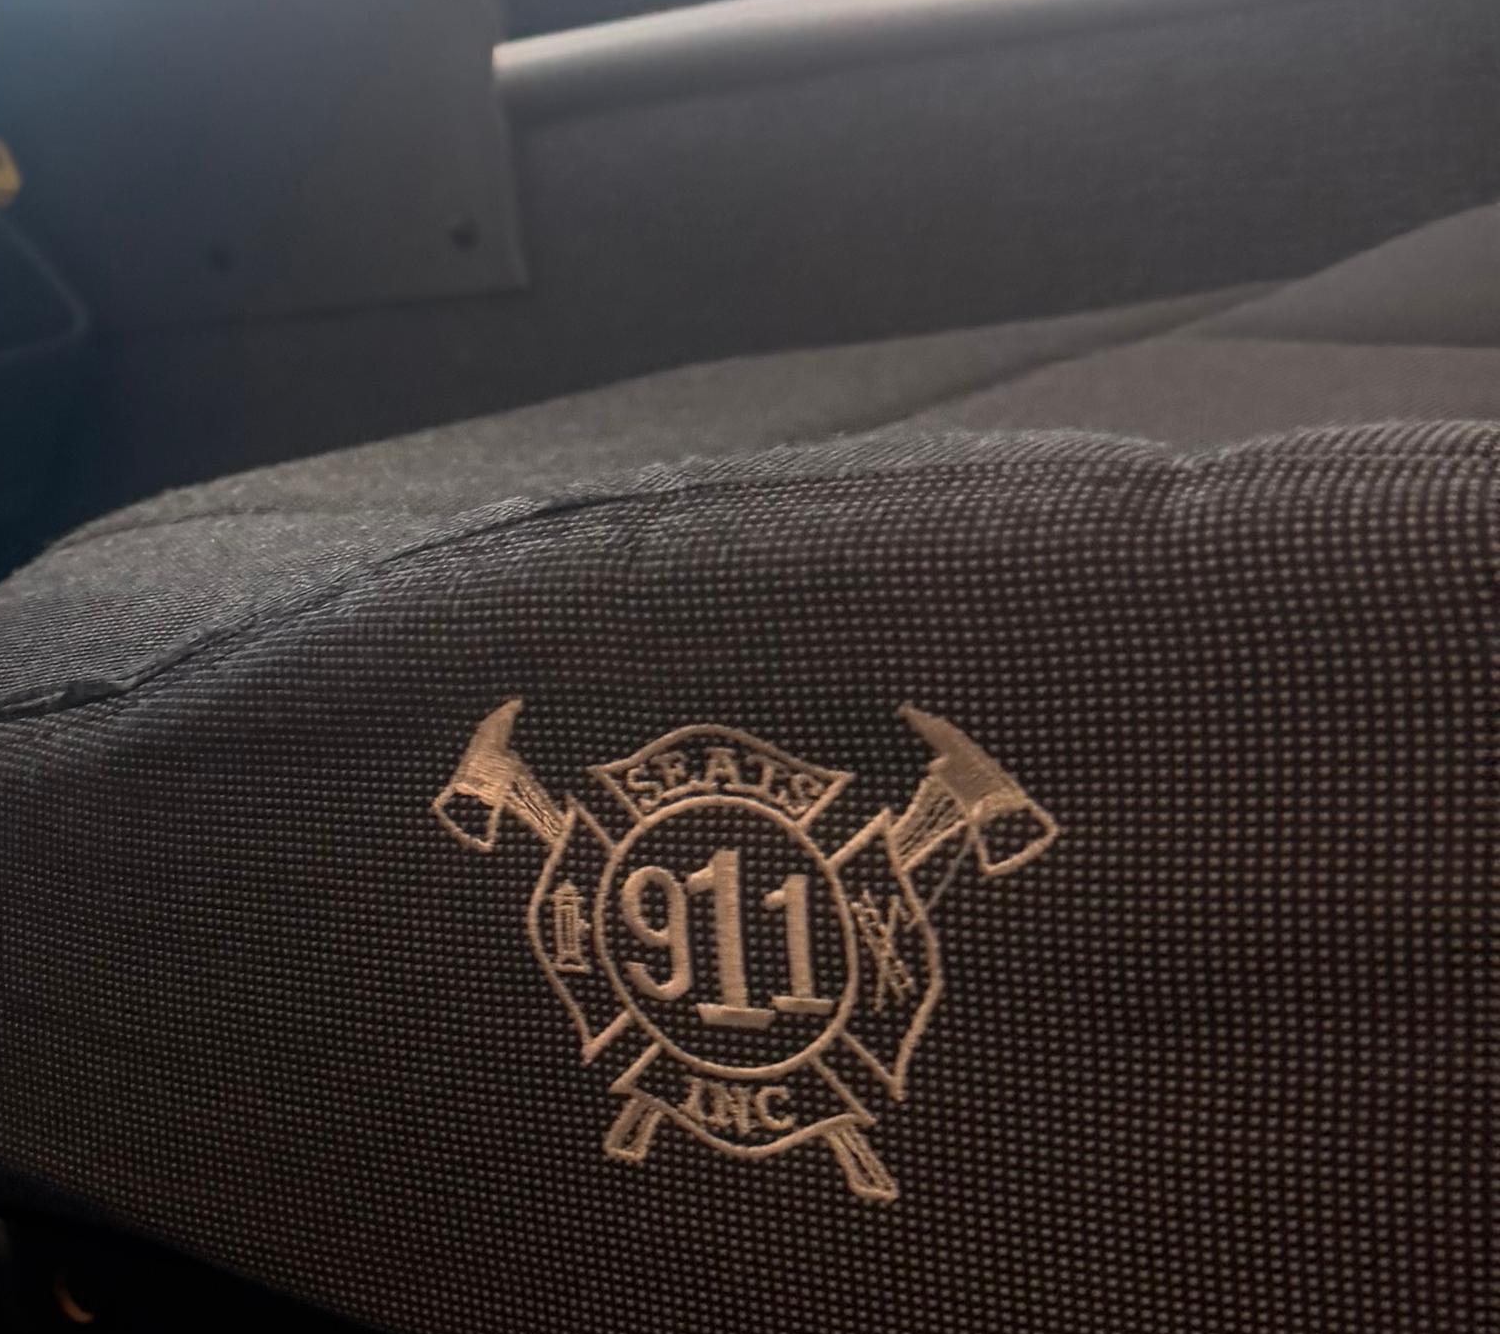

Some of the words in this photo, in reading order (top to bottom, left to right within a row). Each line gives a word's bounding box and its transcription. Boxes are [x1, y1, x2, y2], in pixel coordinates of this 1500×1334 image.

[626, 747, 824, 814] SEATS
[621, 849, 833, 1028] 911
[677, 1075, 796, 1135] INC
